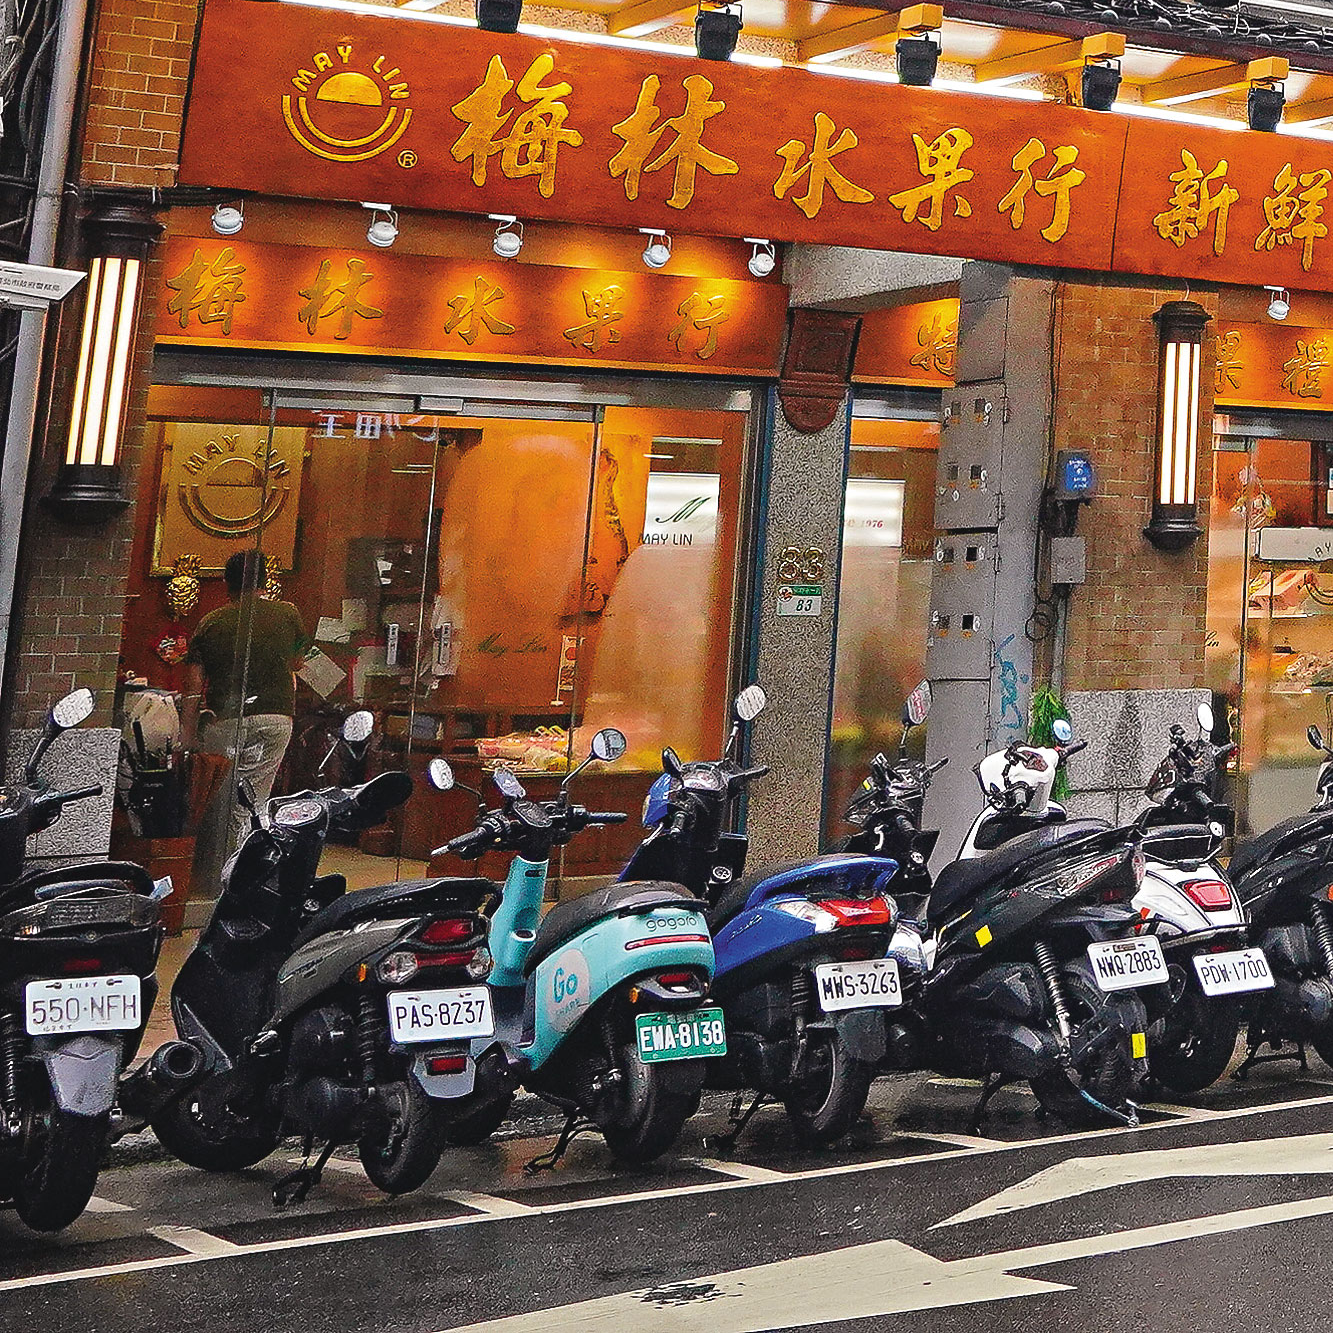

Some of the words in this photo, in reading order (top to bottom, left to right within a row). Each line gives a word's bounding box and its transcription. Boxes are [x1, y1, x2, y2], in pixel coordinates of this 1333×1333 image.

[291, 45, 352, 92] MAY
[372, 55, 410, 100] LIN
[451, 53, 1086, 244] 梅林水果行
[166, 247, 731, 359] 梅林水果行
[672, 532, 692, 546] LIN
[796, 599, 813, 612] 83
[646, 915, 697, 932] gogoro
